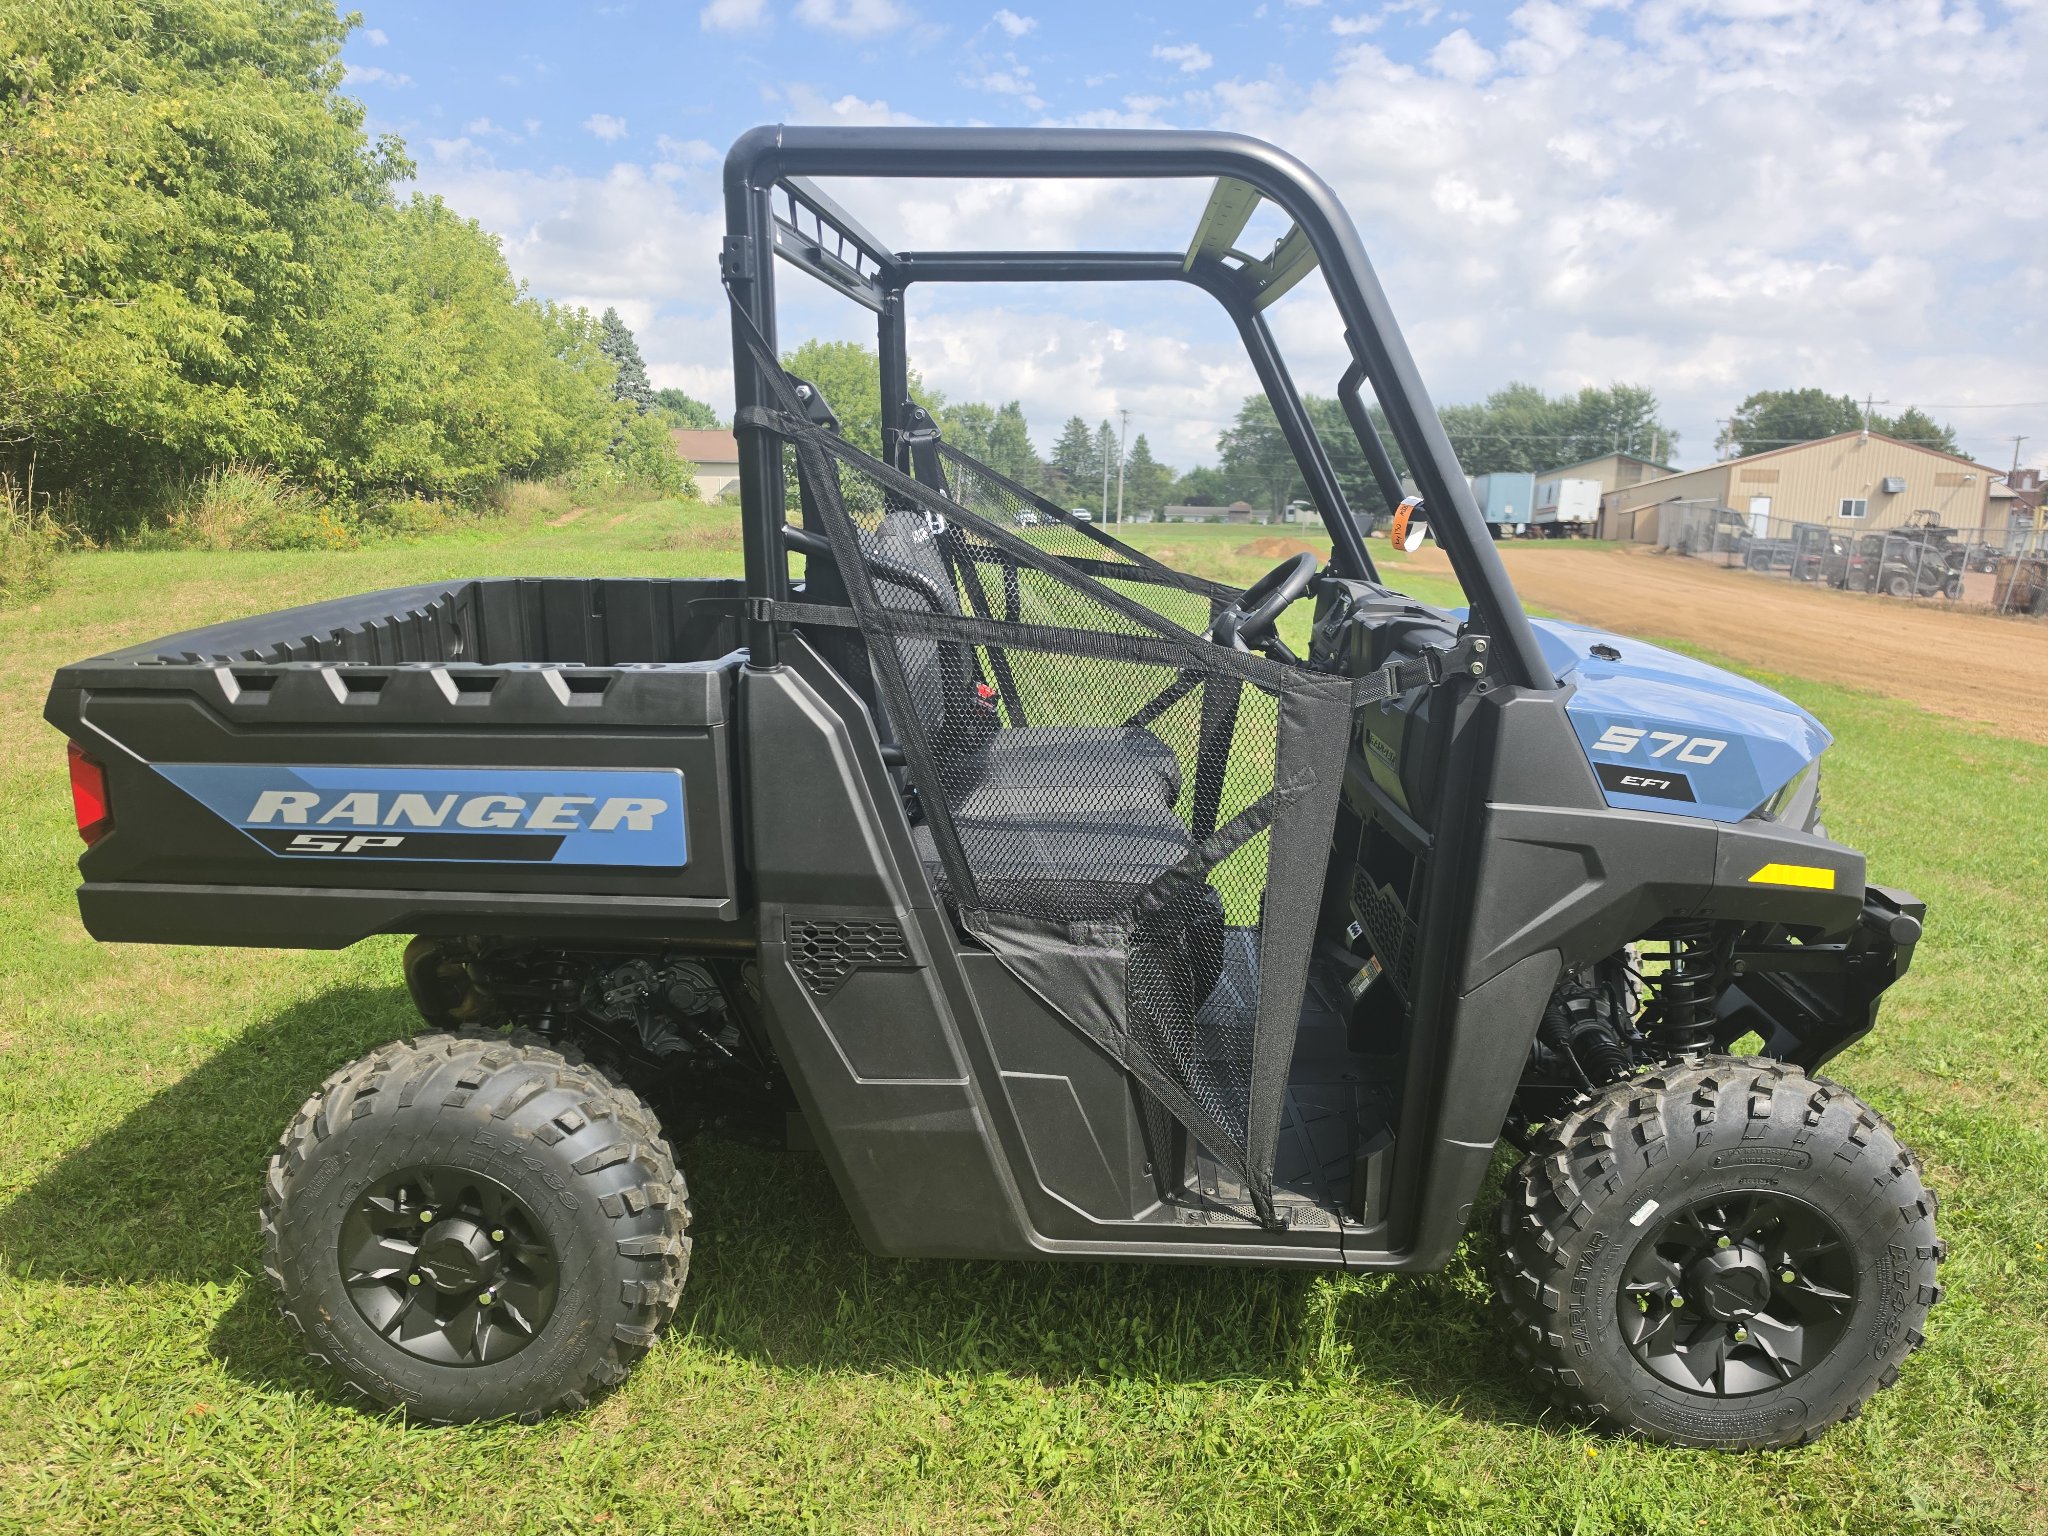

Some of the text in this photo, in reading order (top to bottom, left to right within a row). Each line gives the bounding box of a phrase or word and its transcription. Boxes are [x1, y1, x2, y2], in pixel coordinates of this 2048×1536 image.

[1592, 725, 1728, 765] 570
[1620, 775, 1671, 790] EFI
[247, 790, 668, 831] RANGER
[285, 834, 405, 853] SP
[1569, 1230, 1608, 1358] CARLSTAR
